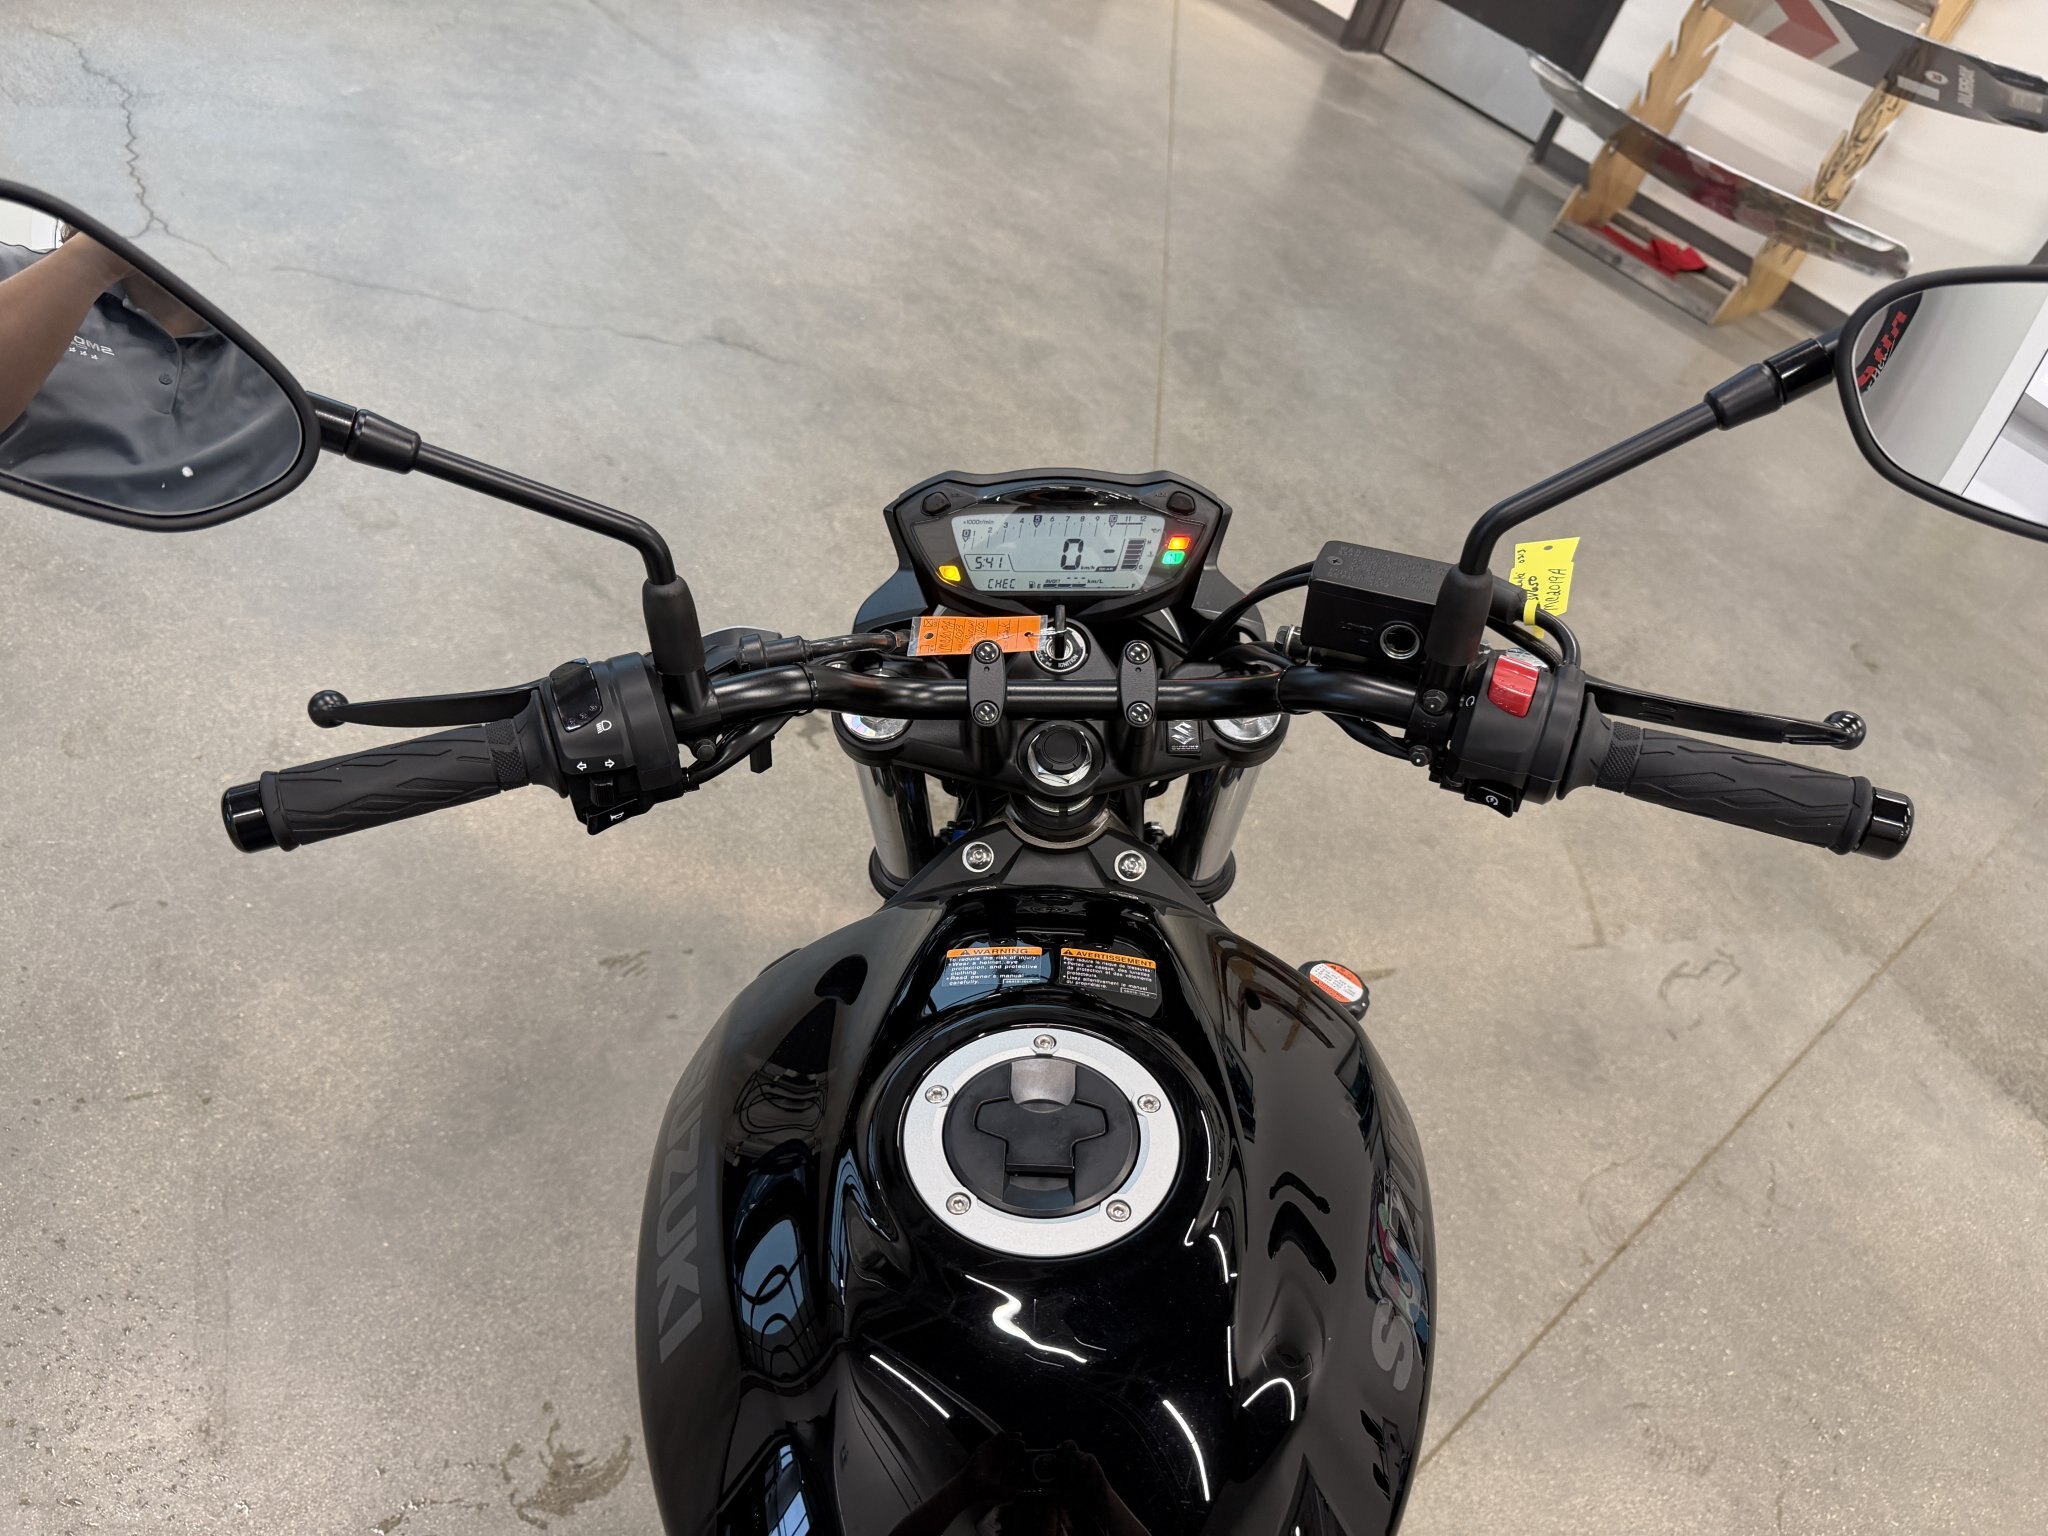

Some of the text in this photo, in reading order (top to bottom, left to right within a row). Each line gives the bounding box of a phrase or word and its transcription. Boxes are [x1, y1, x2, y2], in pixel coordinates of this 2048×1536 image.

[1060, 538, 1084, 570] 0
[975, 556, 1003, 570] 5:41
[987, 578, 1016, 589] CHEC
[1076, 951, 1153, 967] AVERTISSEMENT
[1075, 967, 1104, 975] protection
